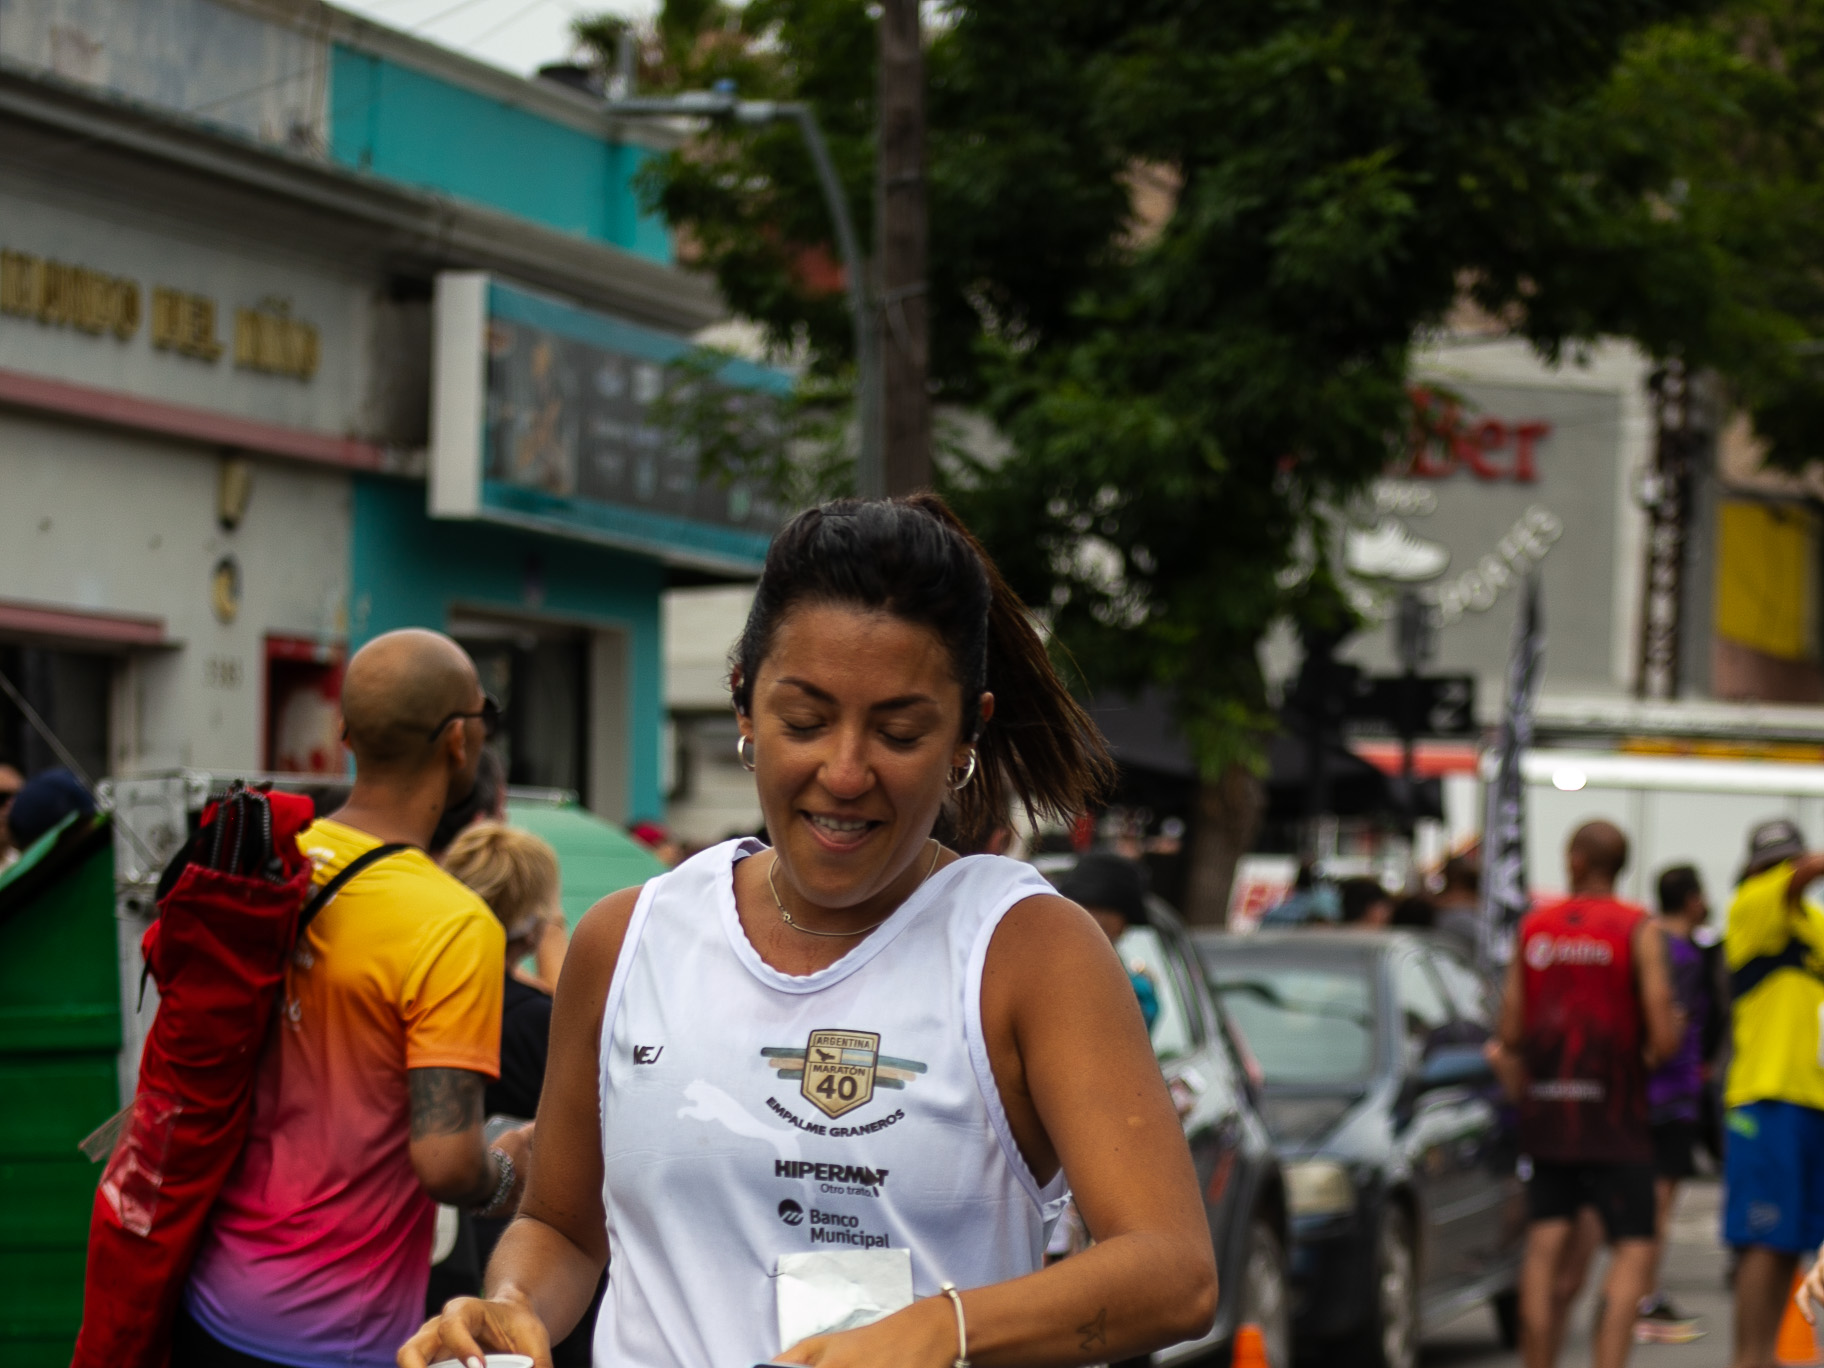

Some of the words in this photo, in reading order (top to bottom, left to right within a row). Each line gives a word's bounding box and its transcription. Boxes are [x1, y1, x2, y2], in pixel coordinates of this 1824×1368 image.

[815, 1036, 871, 1049] ARGENTINA
[812, 1064, 866, 1077] MARATÓN
[815, 1074, 858, 1101] 40
[765, 1096, 827, 1136] EMPALME
[829, 1108, 906, 1138] GRANEROS
[820, 1183, 845, 1195] Otro
[809, 1208, 859, 1228] Banco
[810, 1227, 890, 1250] Municipal
